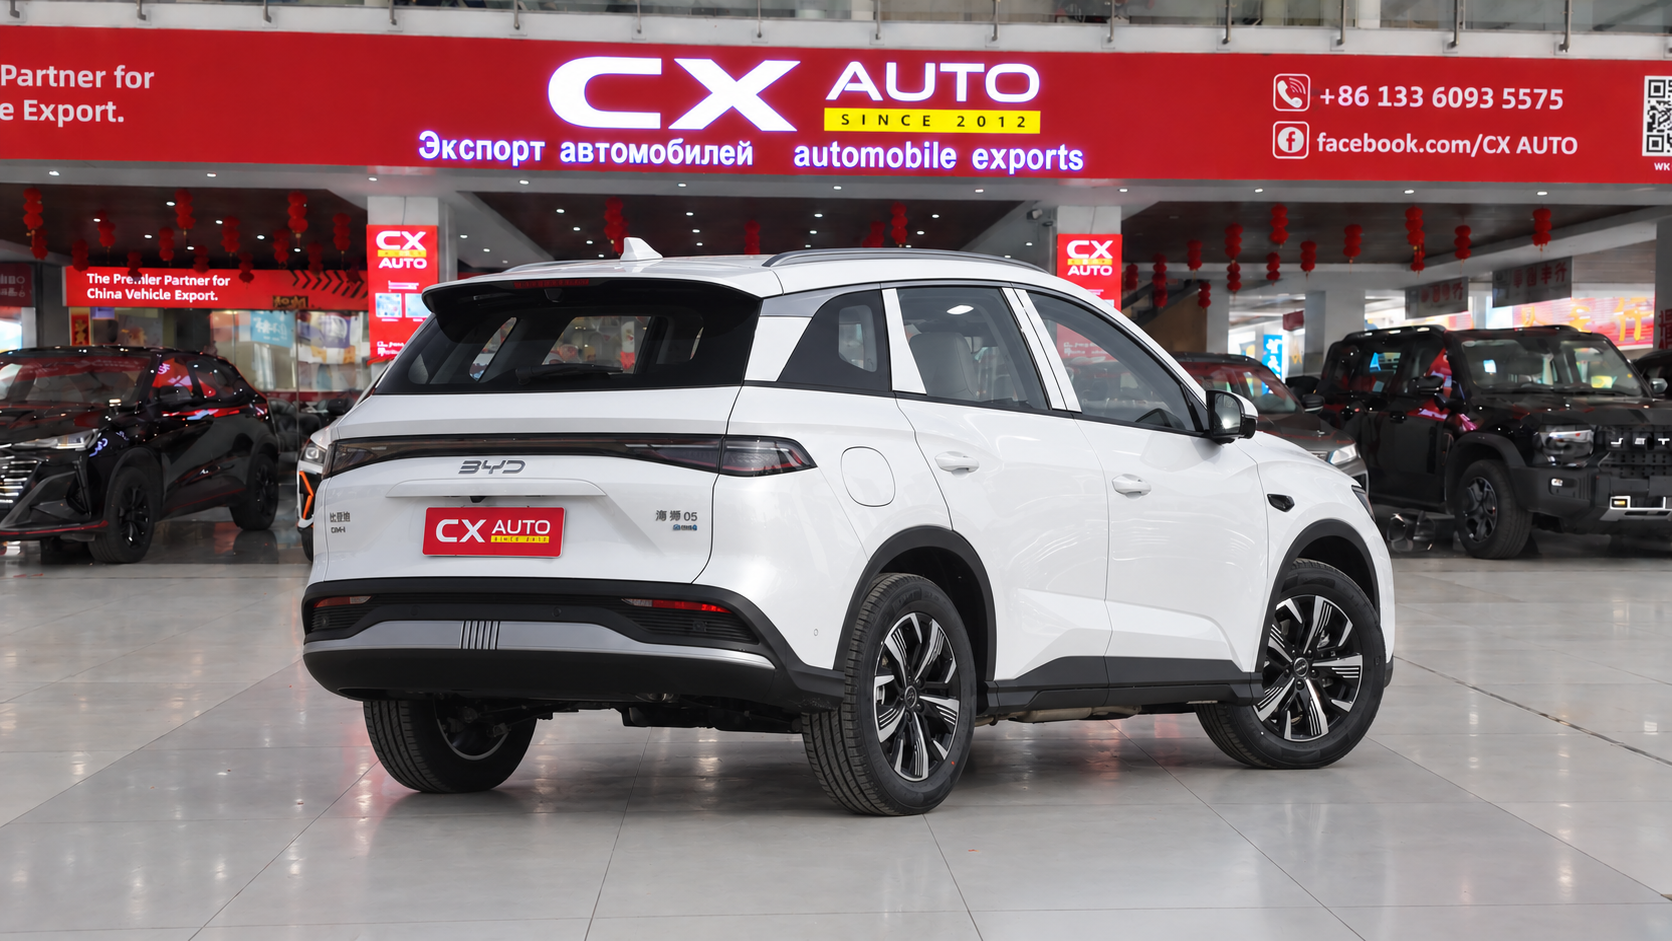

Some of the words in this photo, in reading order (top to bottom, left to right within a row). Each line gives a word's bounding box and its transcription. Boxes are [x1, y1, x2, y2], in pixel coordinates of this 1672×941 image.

[0, 64, 106, 88] Partner
[114, 65, 155, 89] for
[548, 56, 801, 132] CX
[825, 61, 1040, 102] AUTO
[1320, 85, 1369, 107] +86
[1377, 86, 1424, 107] 133
[1432, 87, 1494, 109] 6093
[1502, 88, 1563, 110] 5575
[24, 100, 125, 128] Export.
[841, 113, 931, 127] SINCE
[957, 116, 1026, 128] 2012
[418, 130, 546, 167] Экспорт
[559, 138, 754, 166] автомобилей
[1316, 132, 1510, 157] facebook.com/CX
[1515, 136, 1578, 155] AUTO
[793, 141, 957, 168] automobile
[971, 144, 1084, 175] exports
[376, 230, 427, 250] CX
[1066, 240, 1113, 259] CX
[378, 257, 427, 269] AUTO
[1067, 265, 1113, 276] AUTO
[86, 273, 110, 284] The
[164, 275, 209, 286] Partner
[212, 275, 231, 286] for
[86, 288, 122, 299] China
[125, 289, 171, 300] Vehicle
[174, 290, 219, 303] Export.
[458, 459, 526, 475] BYD
[683, 511, 698, 521] 05
[436, 519, 487, 543] CX
[491, 519, 551, 535] AUTO
